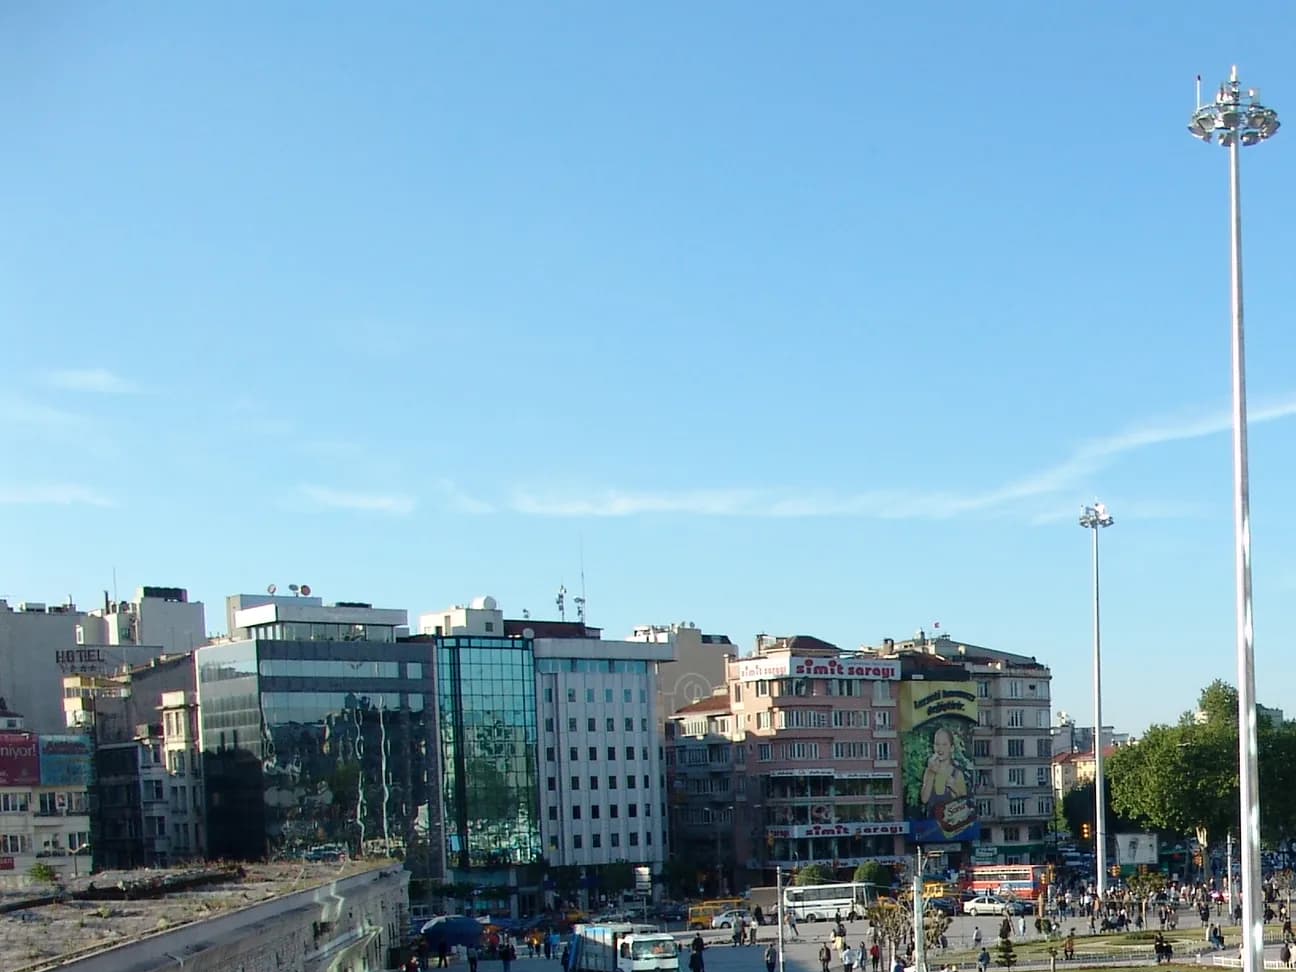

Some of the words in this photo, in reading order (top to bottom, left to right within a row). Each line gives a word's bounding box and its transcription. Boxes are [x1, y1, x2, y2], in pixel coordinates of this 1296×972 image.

[56, 649, 105, 663] HOTEL
[796, 659, 844, 676] simit
[848, 665, 895, 678] sarayı
[805, 825, 849, 836] simit
